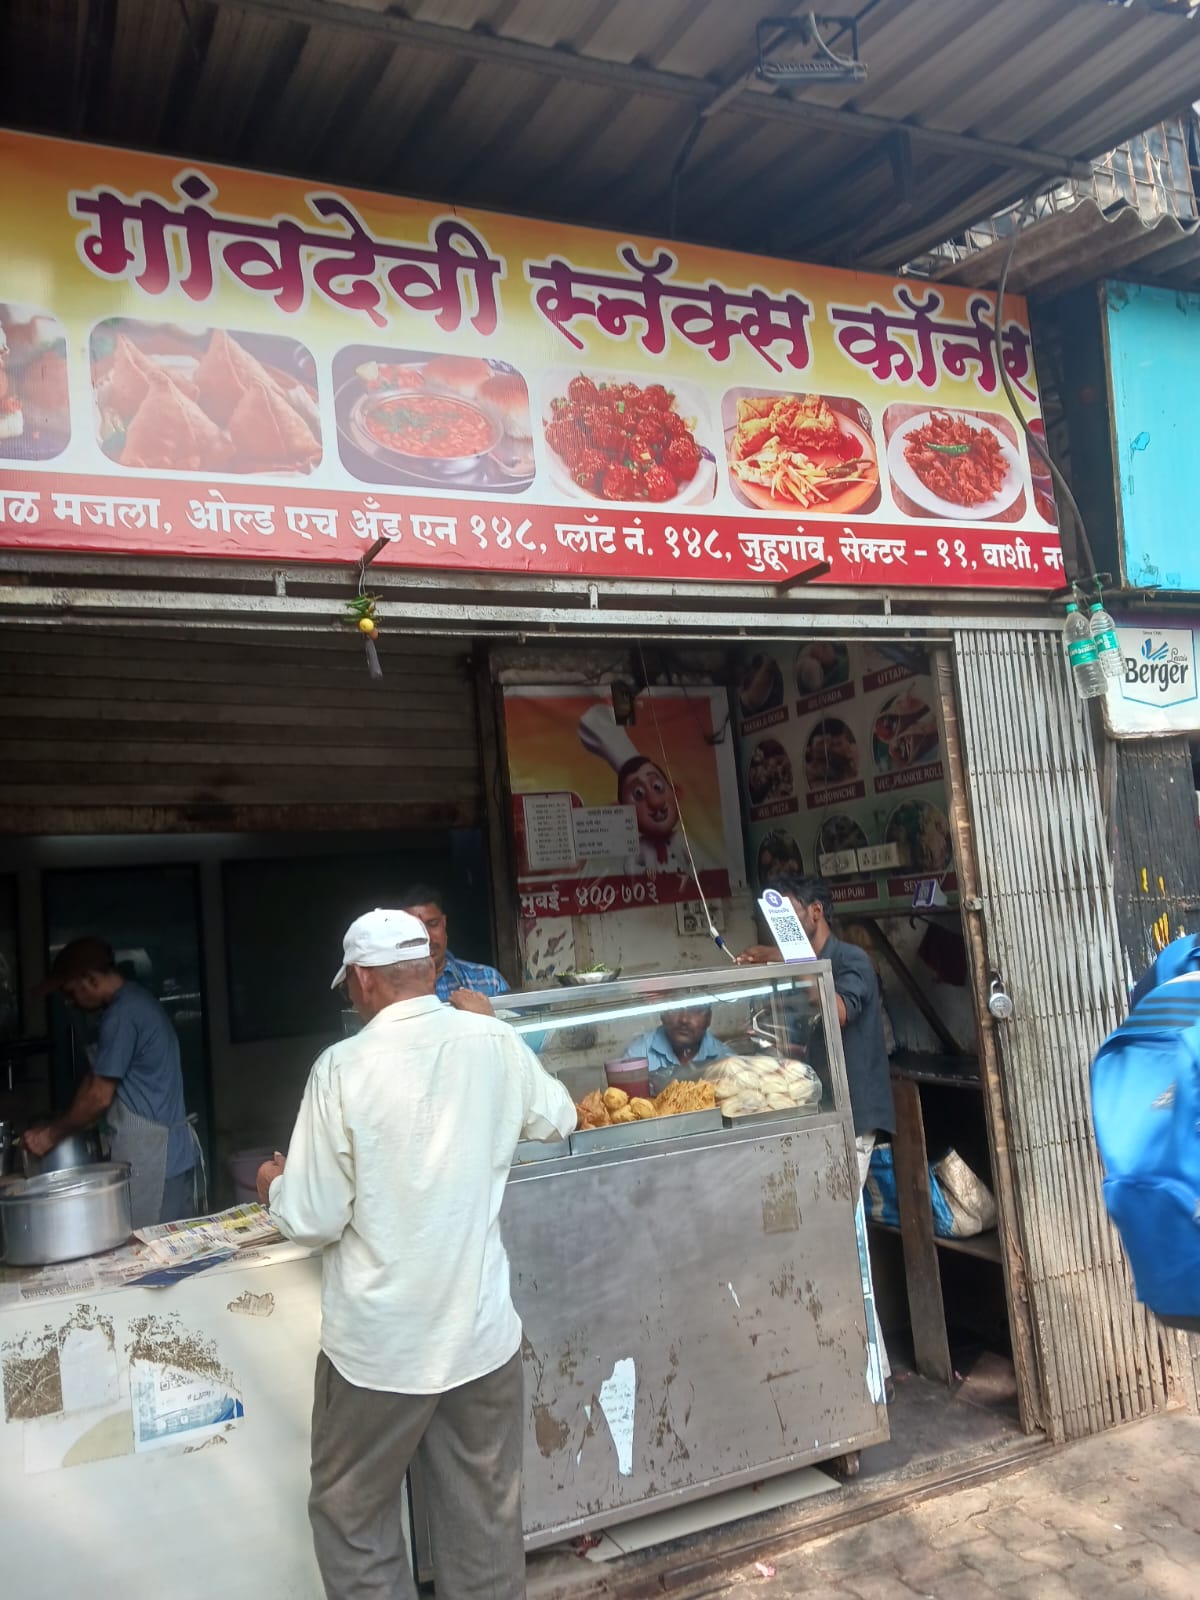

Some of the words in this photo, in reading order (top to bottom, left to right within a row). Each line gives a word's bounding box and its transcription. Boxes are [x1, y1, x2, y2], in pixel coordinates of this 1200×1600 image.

[76, 175, 501, 336] गांवदेवी
[529, 247, 809, 372] स्नॅक्स
[832, 288, 1037, 402] कॉर्नर
[51, 492, 172, 534] मजला,
[185, 489, 276, 535] ओल्ड
[284, 506, 338, 540] एच
[350, 496, 402, 543] अँड
[410, 514, 457, 547] एन
[470, 514, 547, 554] १४८,
[554, 514, 616, 554] प्लॉट
[622, 517, 654, 556] नं.
[664, 525, 732, 563] १४८,
[738, 526, 833, 572] जुहूगांव,
[838, 527, 908, 566] सेक्टर
[936, 538, 977, 571] ११,
[981, 536, 1039, 573] वाशी,
[1125, 657, 1189, 692] Berger
